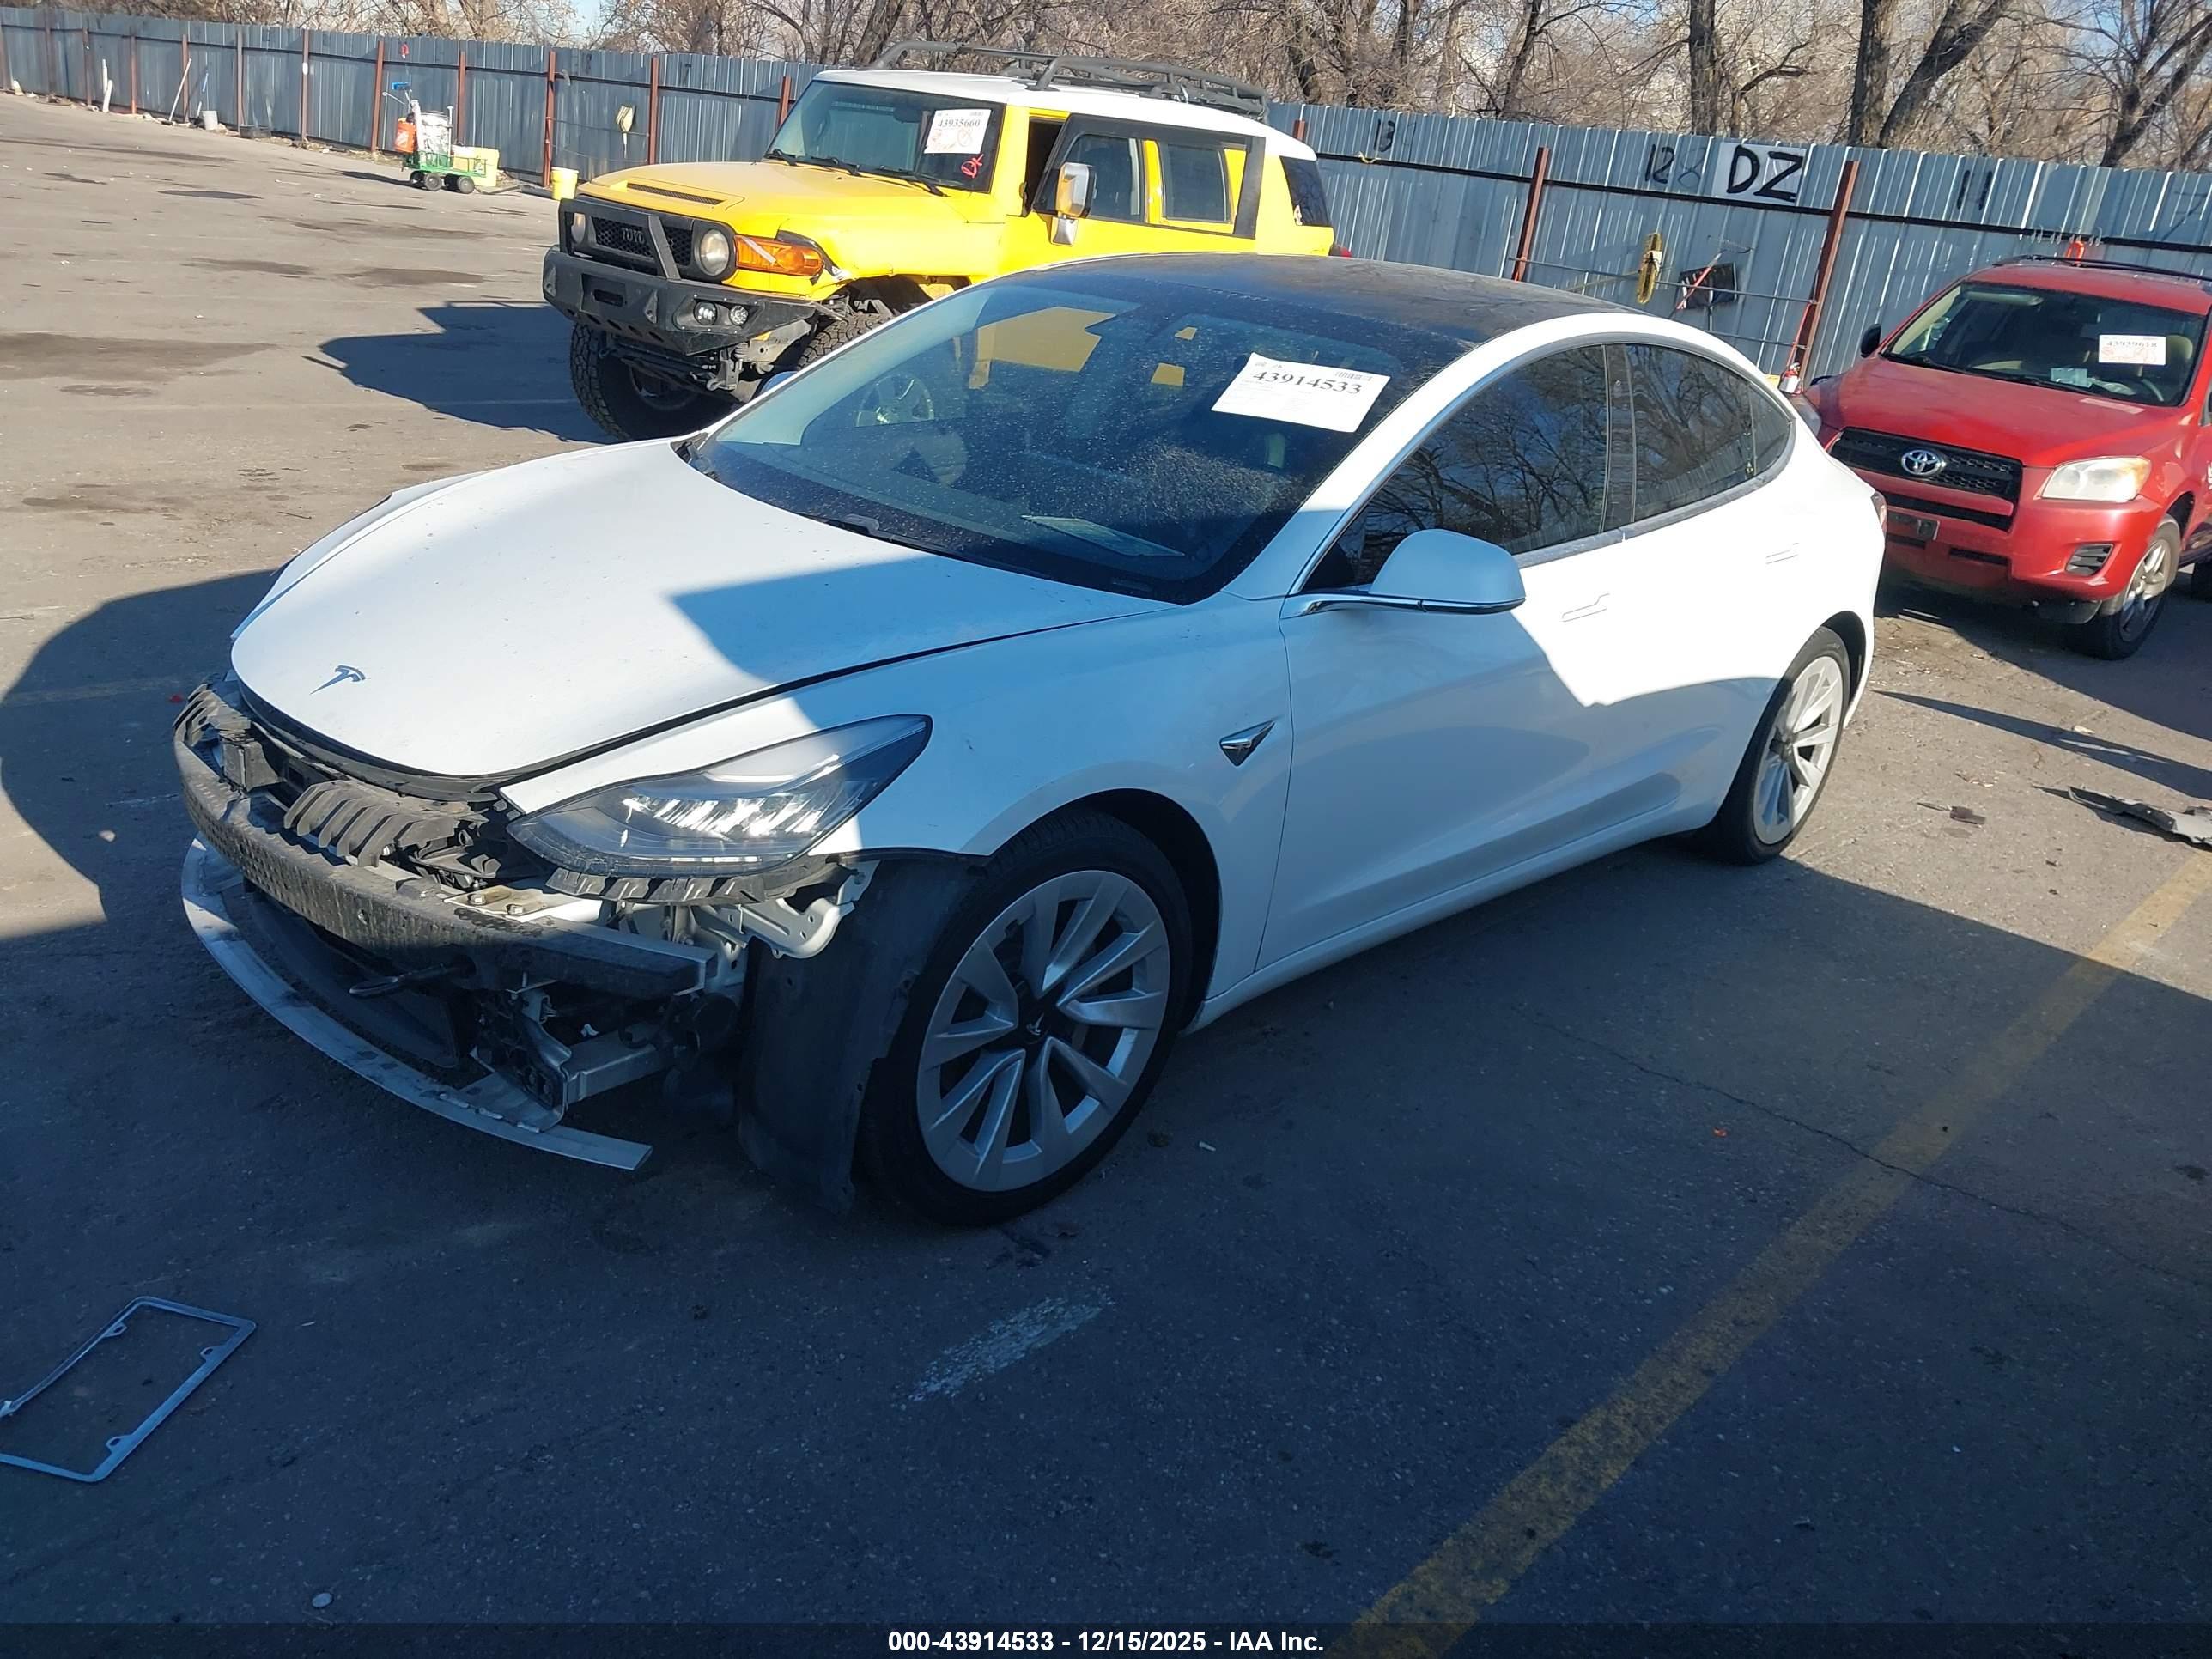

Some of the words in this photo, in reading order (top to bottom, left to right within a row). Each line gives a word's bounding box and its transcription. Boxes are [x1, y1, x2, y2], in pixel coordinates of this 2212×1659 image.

[937, 118, 981, 128] 43935660
[1644, 144, 1675, 184] 12
[1726, 145, 1804, 203] DZ
[1957, 170, 1993, 210] 11
[621, 227, 645, 244] TOYO
[1253, 370, 1363, 394] 43914533
